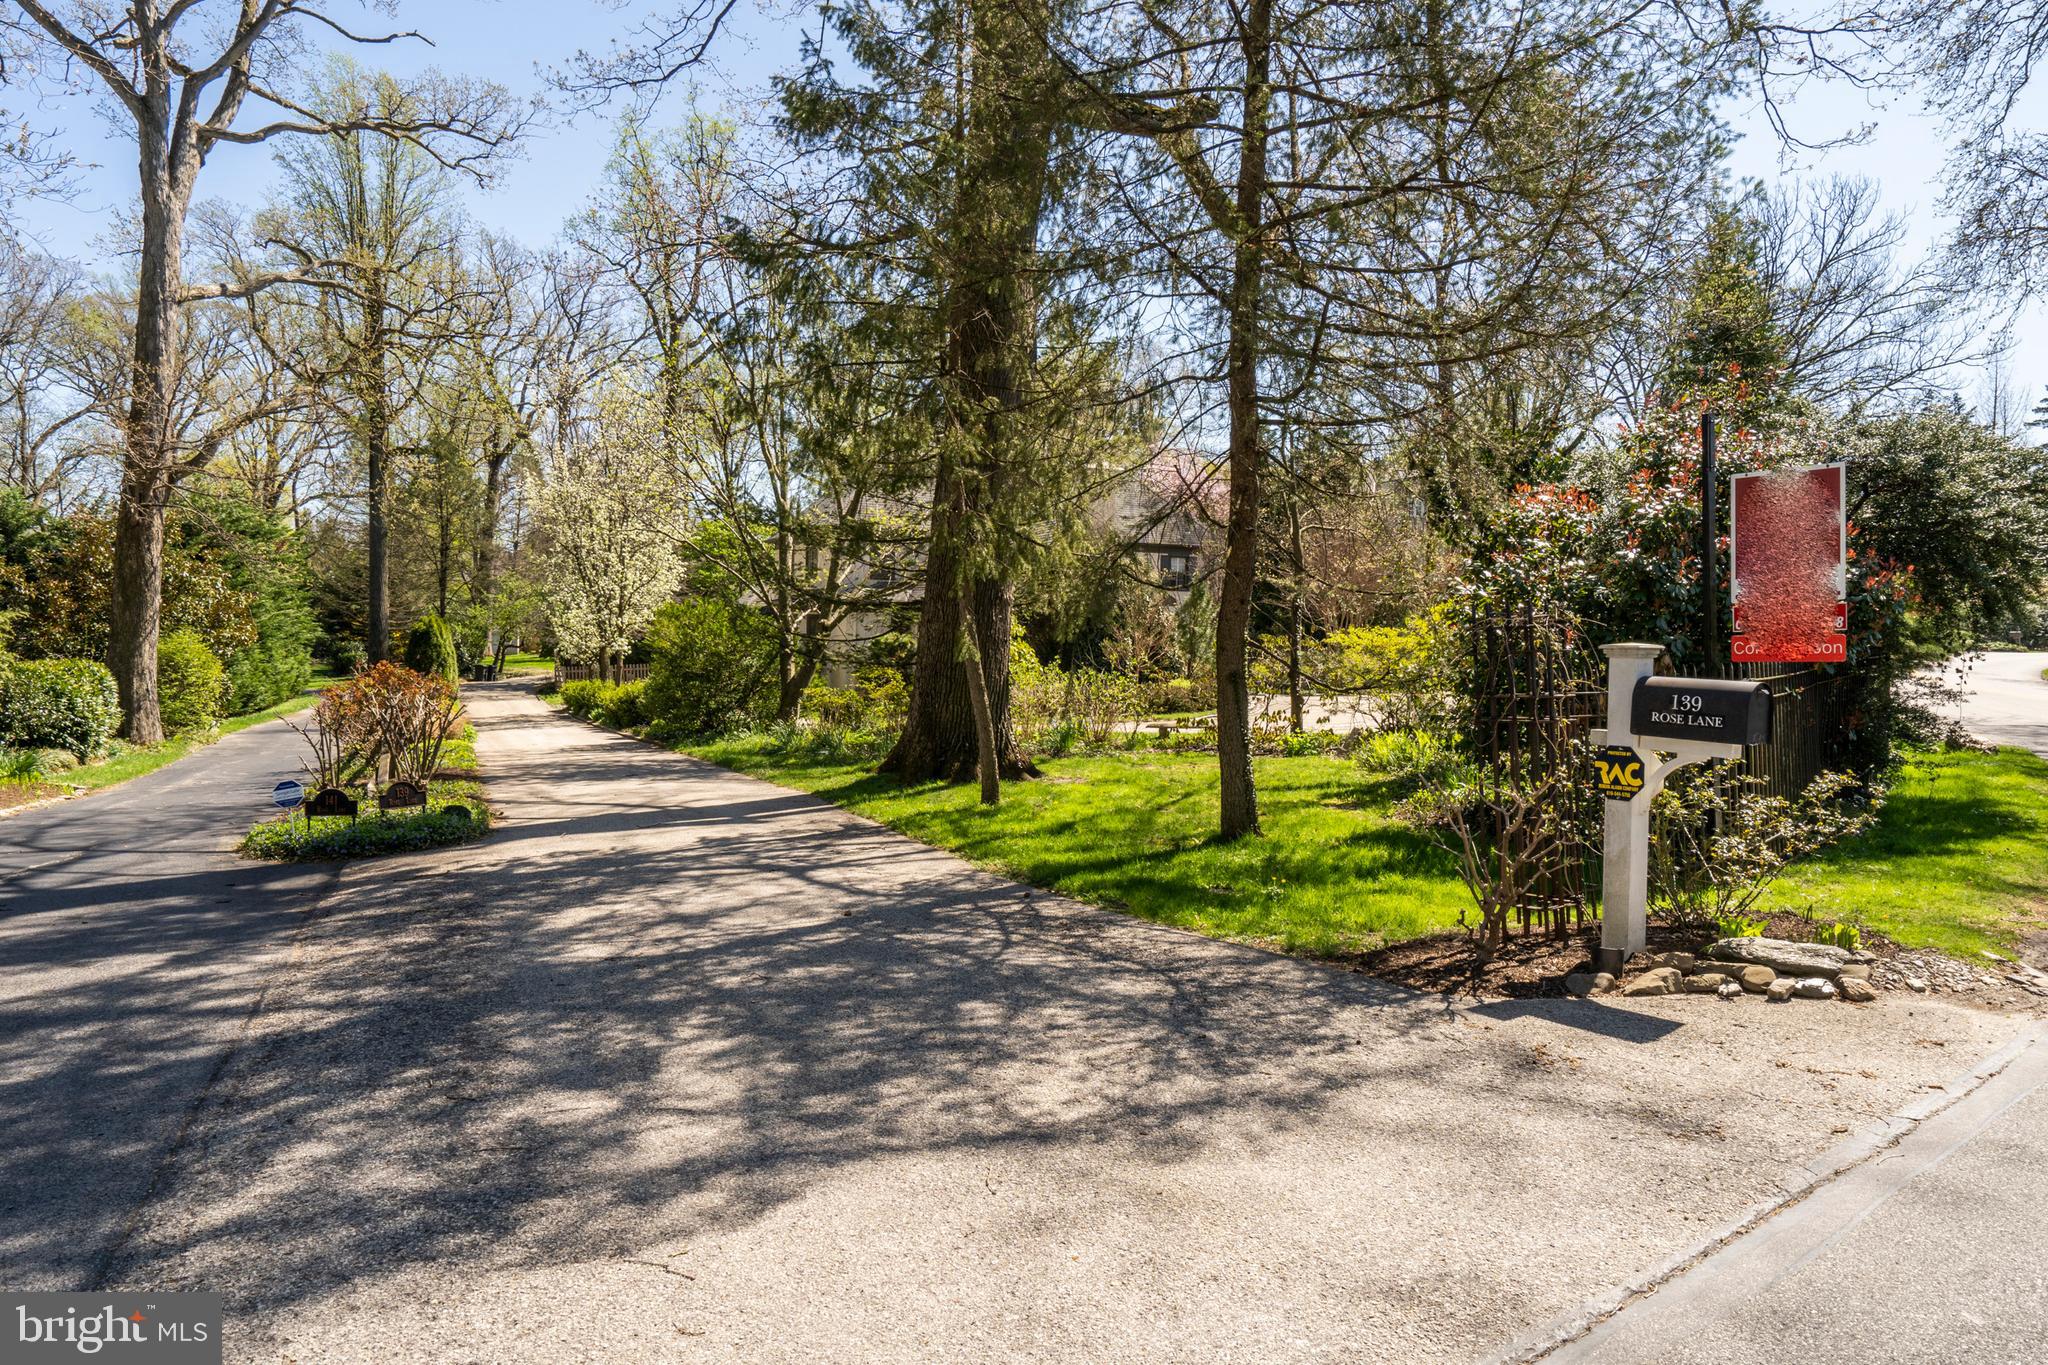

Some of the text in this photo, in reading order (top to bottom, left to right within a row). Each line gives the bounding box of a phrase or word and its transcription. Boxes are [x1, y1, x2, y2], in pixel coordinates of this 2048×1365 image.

[1671, 694, 1702, 712] 139
[1651, 711, 1723, 728] ROSE LANE
[1594, 760, 1643, 787] RAC
